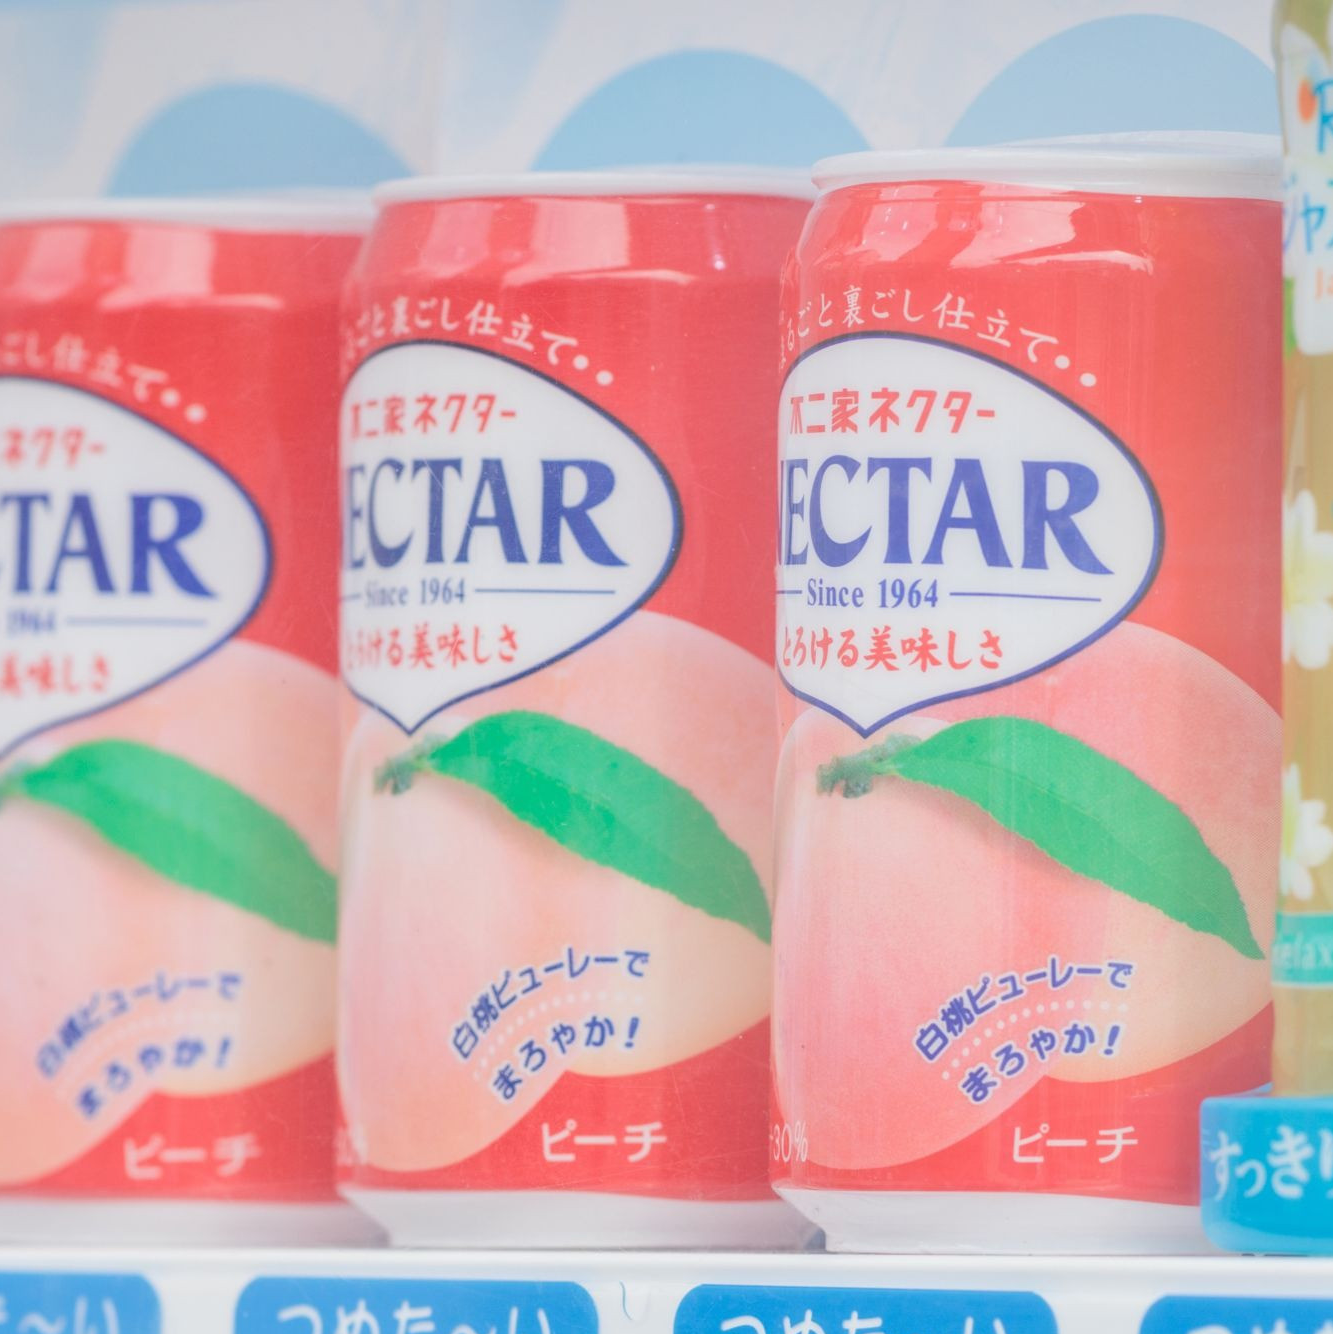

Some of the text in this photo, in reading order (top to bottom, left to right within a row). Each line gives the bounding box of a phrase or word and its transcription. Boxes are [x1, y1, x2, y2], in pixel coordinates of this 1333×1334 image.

[366, 577, 466, 608] Since 1964
[807, 577, 939, 609] Since 1964
[783, 625, 1004, 672] とろける美味しさ
[452, 946, 650, 1060] 白桃ピューレーで
[915, 957, 1133, 1062] 白桃ピューレーで
[540, 1118, 668, 1163] ピーチ
[1012, 1123, 1139, 1164] ピーチ
